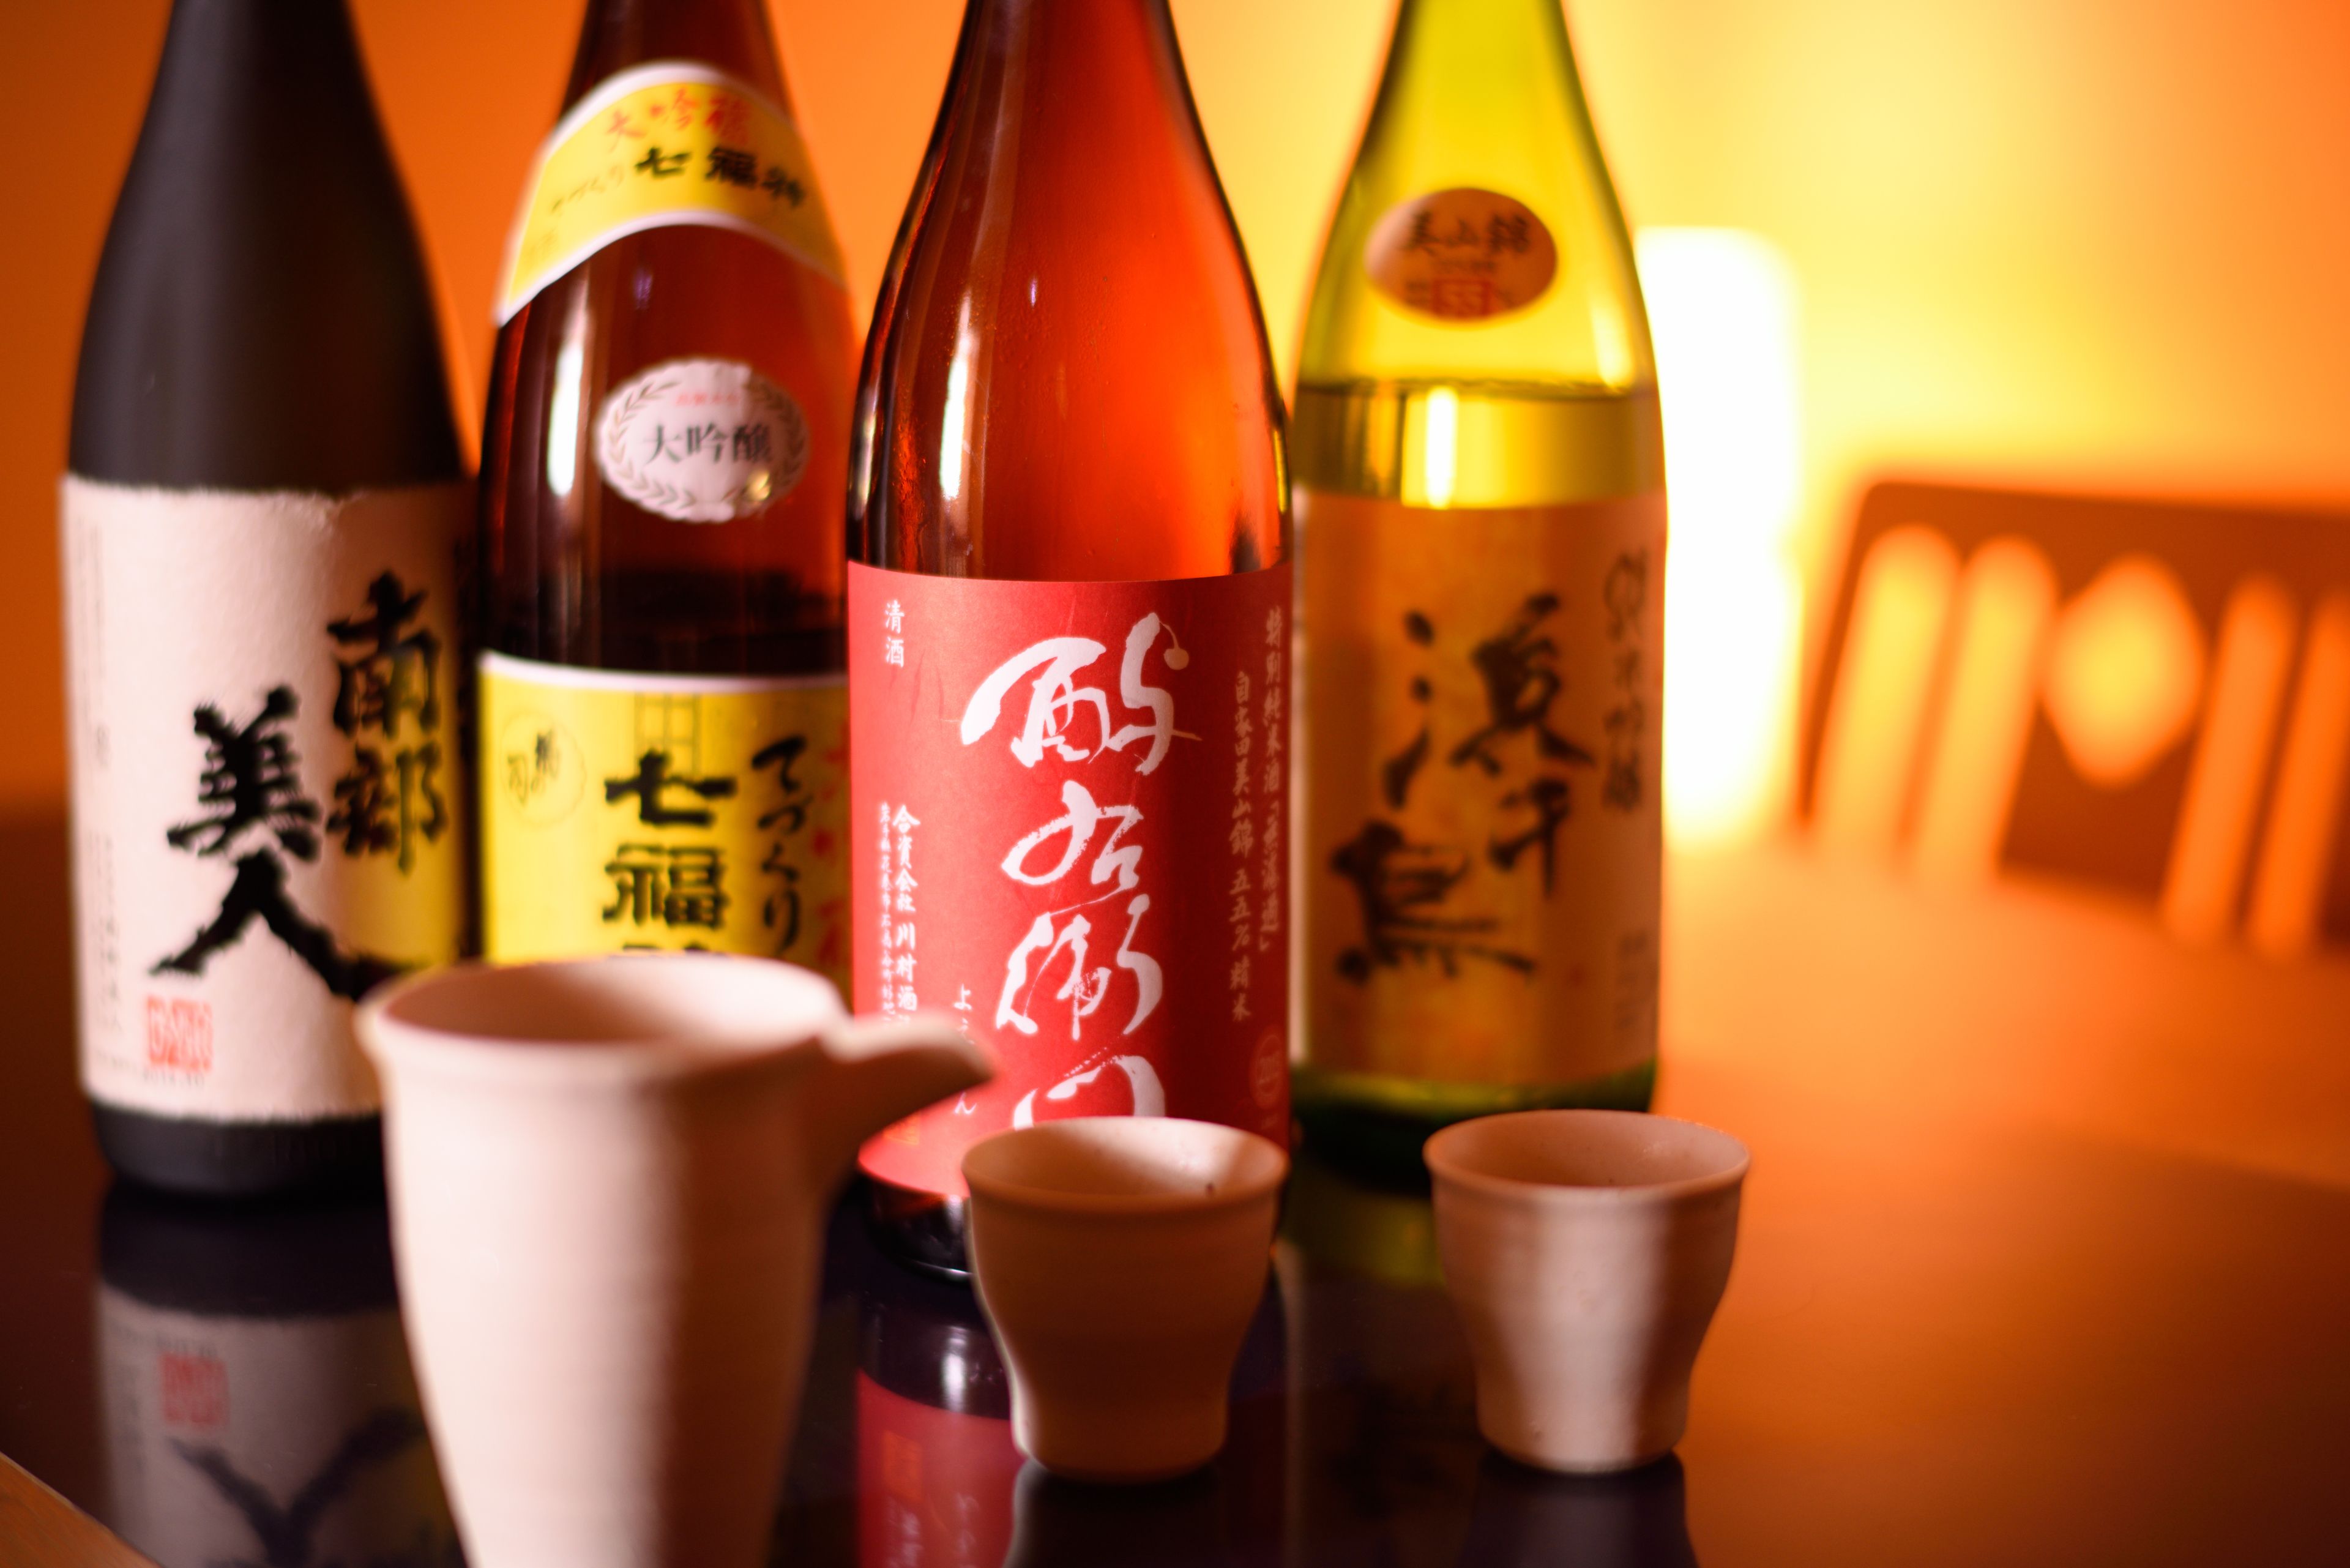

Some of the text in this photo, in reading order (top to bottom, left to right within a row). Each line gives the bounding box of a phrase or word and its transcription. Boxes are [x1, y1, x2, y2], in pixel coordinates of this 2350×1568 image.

[634, 146, 807, 209] 七福神
[643, 422, 772, 464] 大吟醸
[885, 600, 905, 667] 清酒
[149, 684, 436, 1001] 美人
[602, 748, 737, 952] 七福
